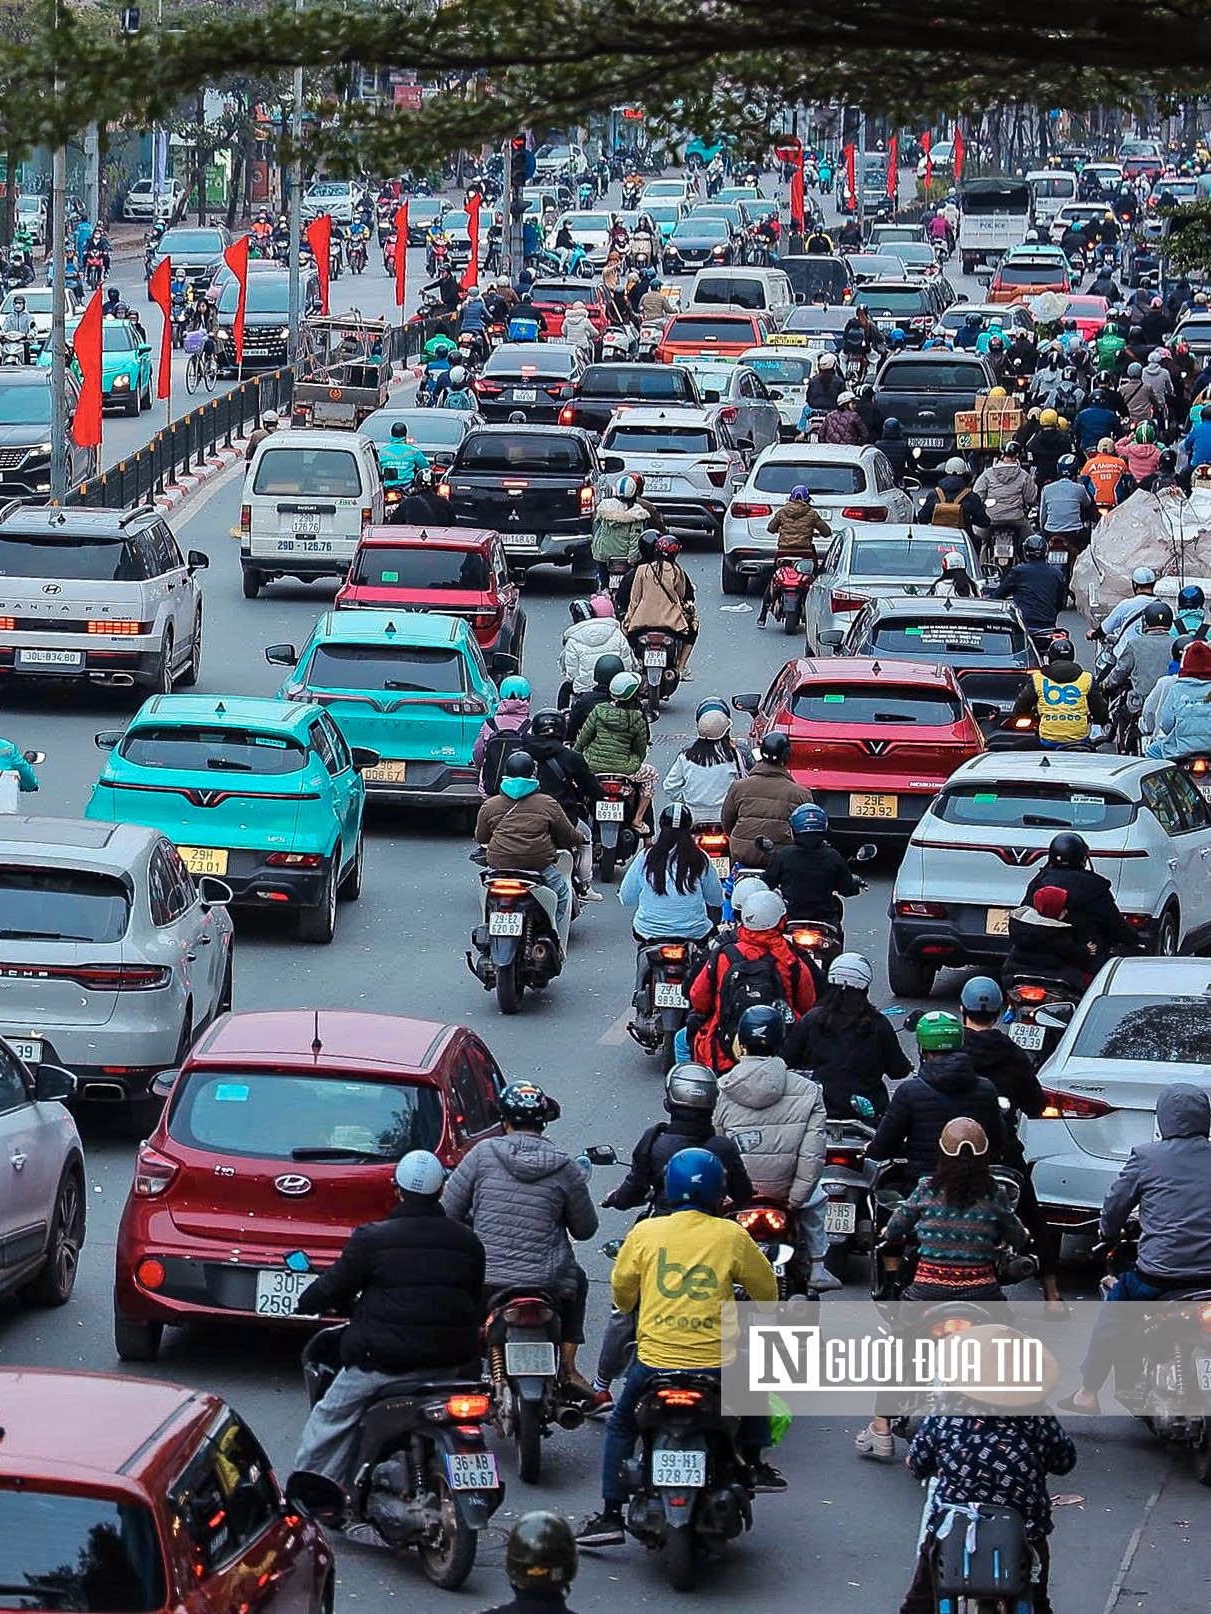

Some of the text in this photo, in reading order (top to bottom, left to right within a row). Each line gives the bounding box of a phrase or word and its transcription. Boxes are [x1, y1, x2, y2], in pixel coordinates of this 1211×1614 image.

[957, 434, 971, 447] C2
[277, 541, 294, 550] 29D
[302, 541, 332, 552] 126.76
[85, 605, 111, 613] FE
[25, 651, 75, 663] 30L-834.80
[1042, 678, 1082, 706] be
[380, 761, 393, 770] 9G
[864, 795, 884, 806] 29E
[855, 806, 893, 817] 323.92
[191, 849, 213, 860] 29H
[494, 914, 518, 925] 29-E2
[993, 921, 1009, 933] 42
[661, 985, 681, 995] 29-L
[1014, 1025, 1040, 1038] 29-B2
[15, 1044, 34, 1058] 39
[655, 1247, 719, 1301] be
[273, 1273, 308, 1293] 30F
[259, 1293, 293, 1315] 259
[455, 1455, 490, 1471] 36-AB
[454, 1471, 495, 1488] 946.67
[656, 1469, 702, 1484] 328.73
